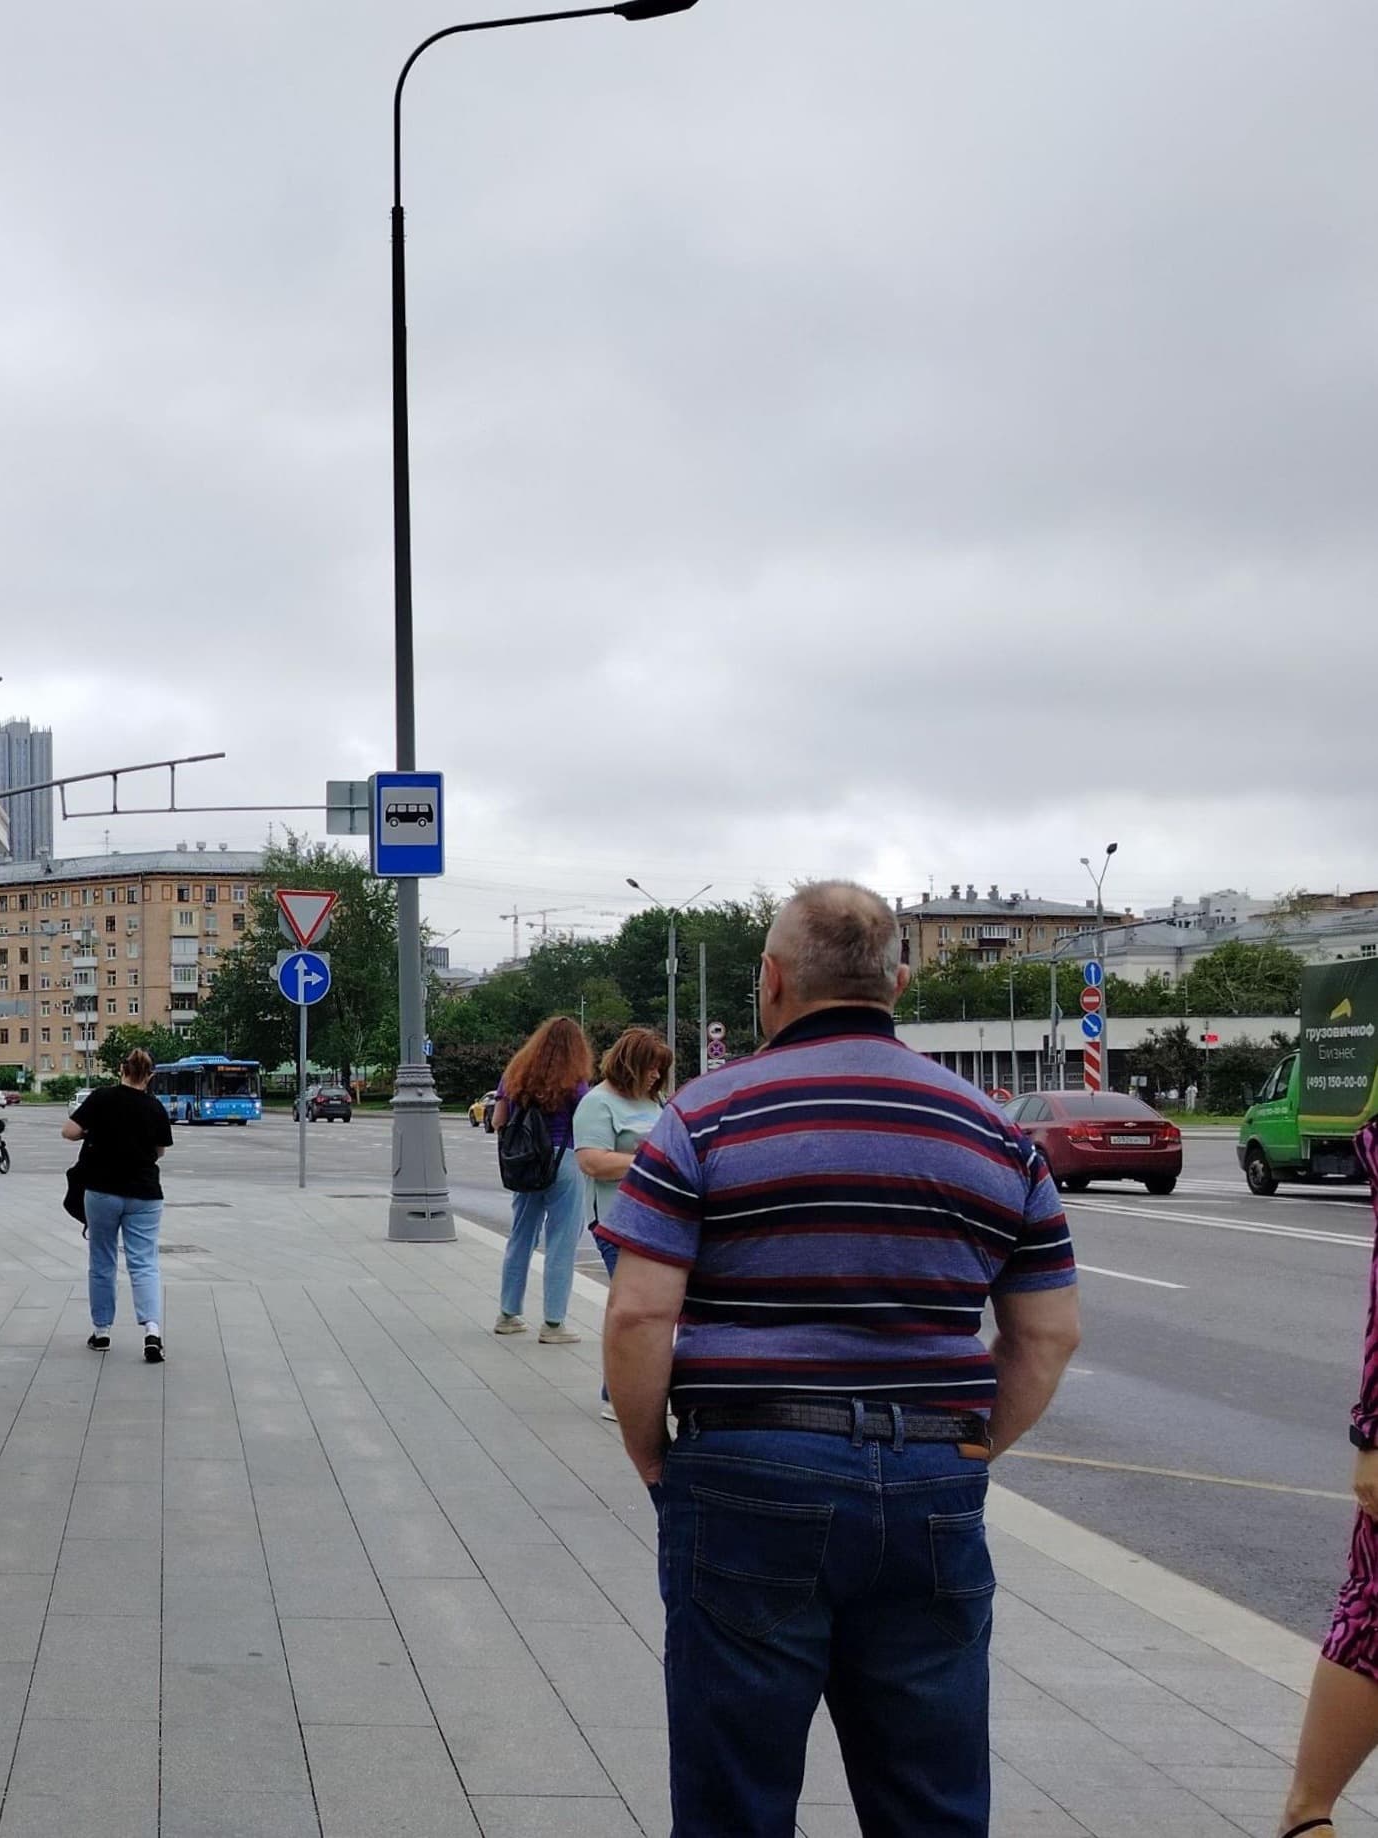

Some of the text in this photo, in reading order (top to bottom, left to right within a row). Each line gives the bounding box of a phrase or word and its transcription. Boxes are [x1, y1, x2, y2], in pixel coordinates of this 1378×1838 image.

[1305, 1023, 1375, 1042] грузовичкоф
[1318, 1044, 1357, 1061] Бизнес
[1306, 1075, 1368, 1090] (495) 150-00-00
